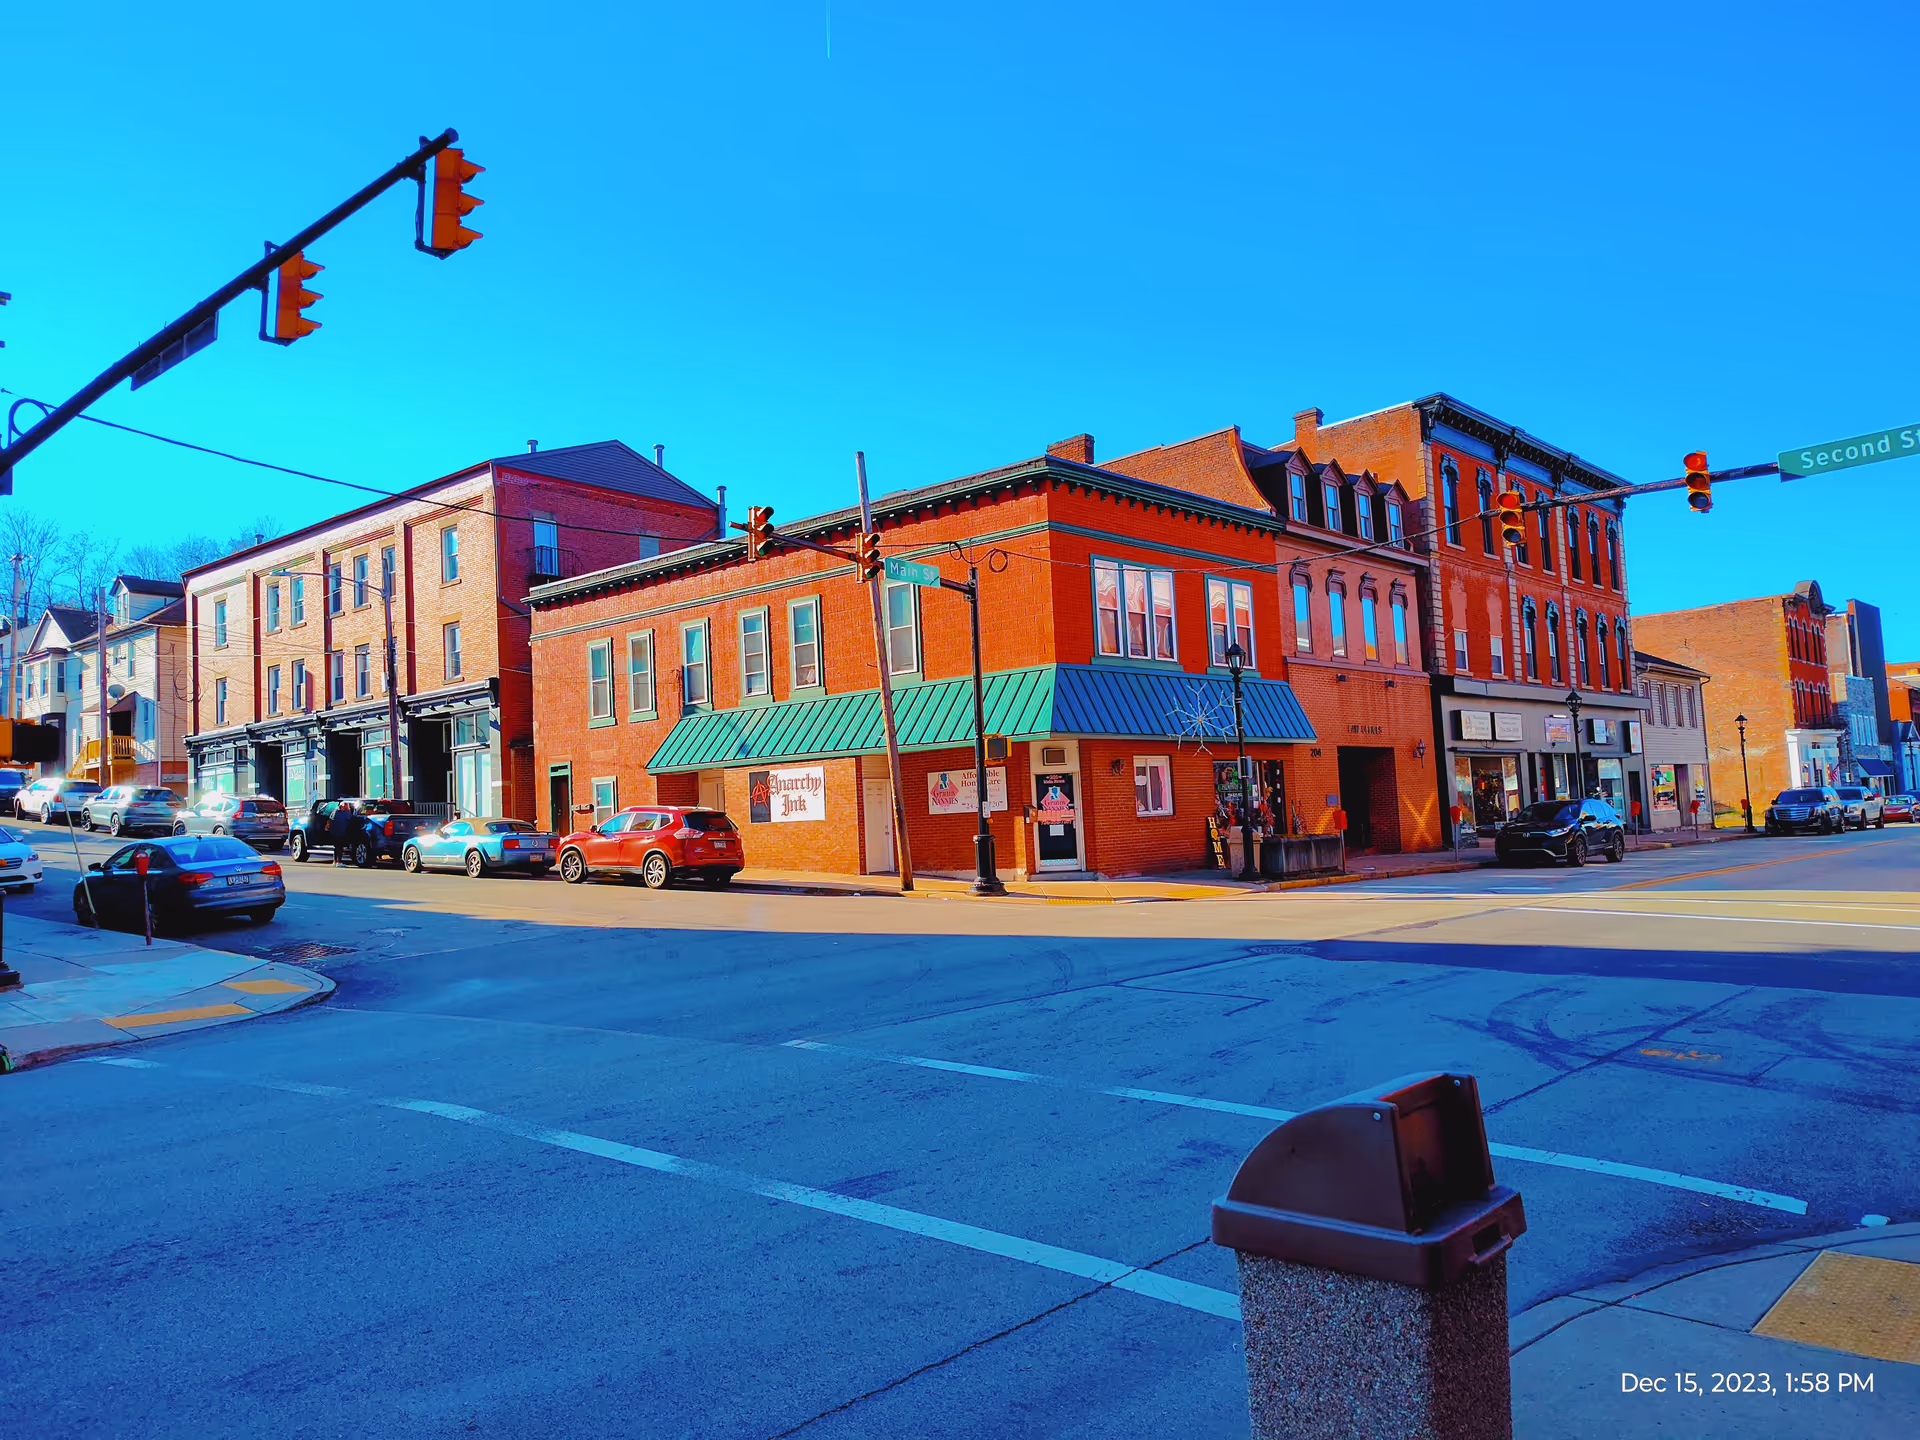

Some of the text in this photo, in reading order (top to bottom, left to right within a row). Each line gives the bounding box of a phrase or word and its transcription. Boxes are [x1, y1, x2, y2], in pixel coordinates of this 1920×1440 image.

[1800, 434, 1891, 469] Second
[890, 561, 935, 580] Main St
[766, 773, 822, 797] Anarchy
[781, 794, 808, 817] Ink
